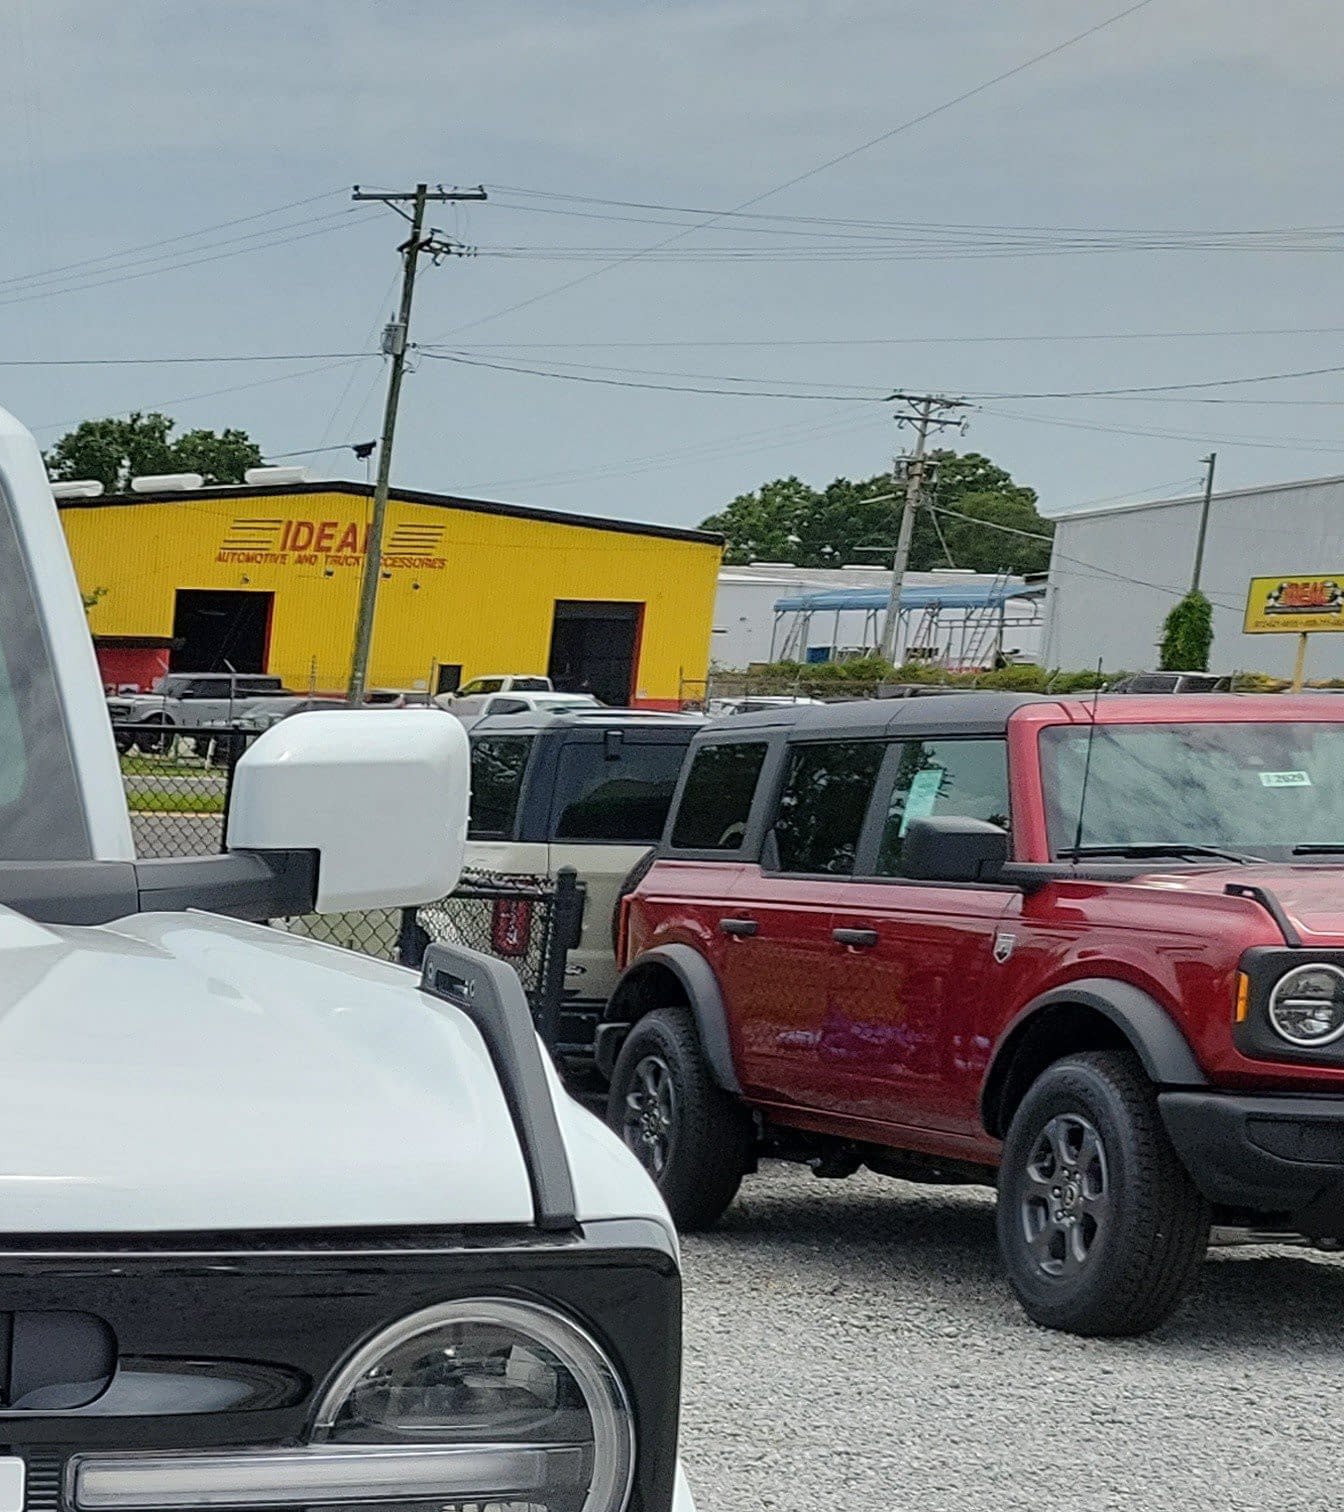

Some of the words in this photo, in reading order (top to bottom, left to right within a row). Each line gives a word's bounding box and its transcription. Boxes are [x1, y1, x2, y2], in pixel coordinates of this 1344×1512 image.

[215, 551, 288, 565] AUTOMOTIVE
[294, 554, 317, 566] AND
[325, 555, 361, 567] TRUCK
